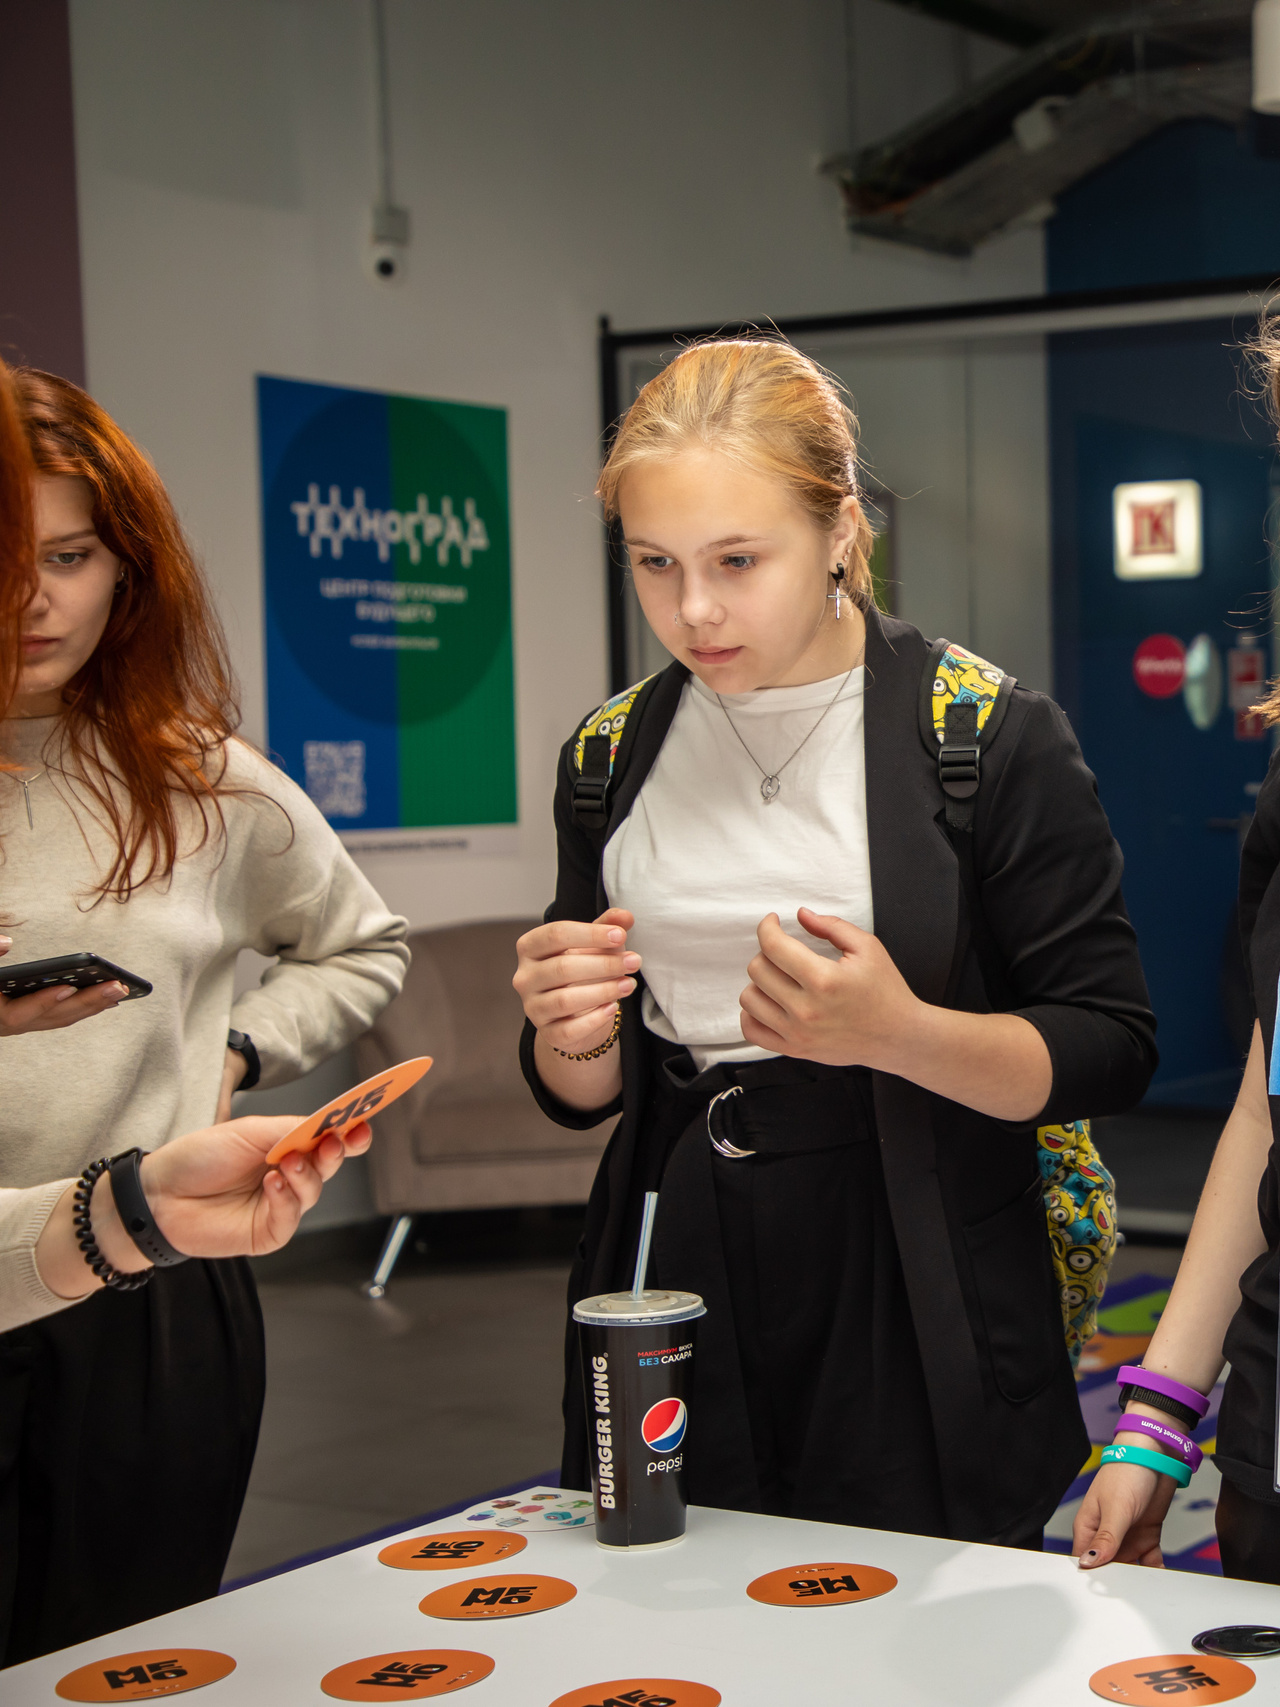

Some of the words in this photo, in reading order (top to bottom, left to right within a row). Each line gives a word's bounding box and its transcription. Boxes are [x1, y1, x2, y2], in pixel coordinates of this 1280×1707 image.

[291, 483, 490, 568] ТЕХНОГРАД
[638, 1357, 660, 1367] БЕЗ
[661, 1350, 693, 1364] САХАРА
[1141, 1420, 1163, 1434] forum
[1163, 1429, 1184, 1445] foxnet
[596, 1418, 616, 1509] BURGER
[646, 1452, 684, 1476] pepsi
